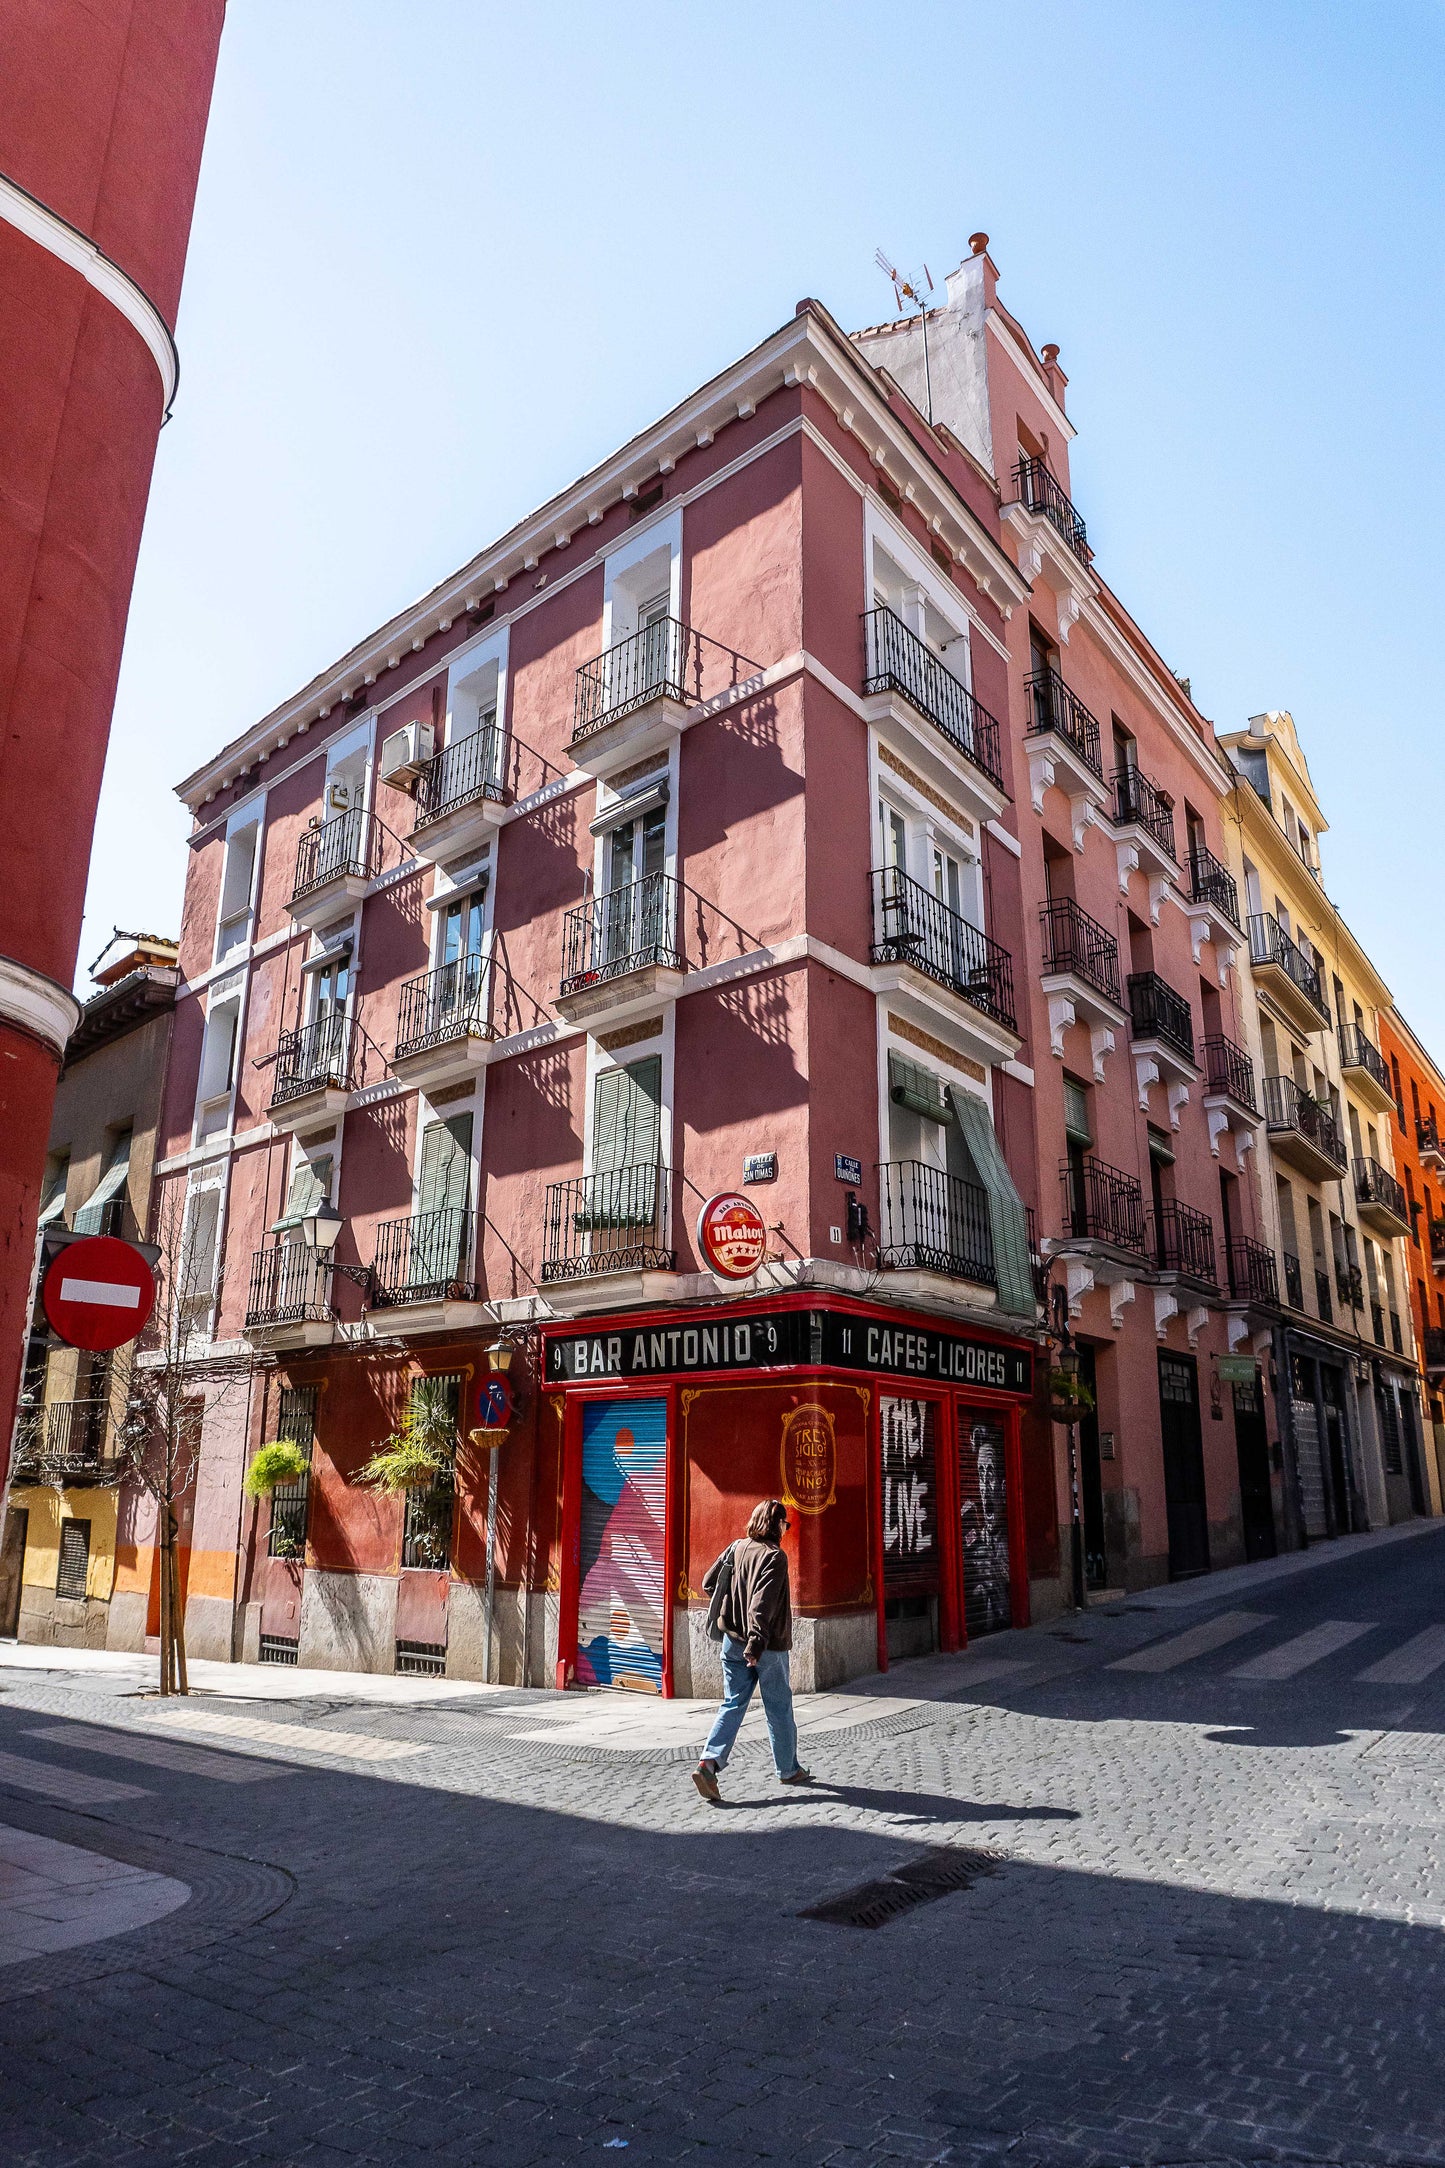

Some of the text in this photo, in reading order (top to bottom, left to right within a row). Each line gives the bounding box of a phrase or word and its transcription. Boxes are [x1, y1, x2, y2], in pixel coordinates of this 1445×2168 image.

[751, 1155, 774, 1165] CALLE
[844, 1158, 859, 1169] CALLE
[743, 1167, 773, 1182] SAN DIMAS
[718, 1203, 731, 1215] BAR
[713, 1223, 764, 1242] Mahou
[833, 1230, 840, 1242] 11
[553, 1323, 778, 1375] 9 BAR ANTONIO 9
[841, 1327, 852, 1354] 11
[1015, 1361, 1024, 1383] 11
[795, 1428, 827, 1446] TRES
[880, 1396, 927, 1472] THEY
[795, 1473, 827, 1489] VINOS
[883, 1470, 933, 1557] LIVE
